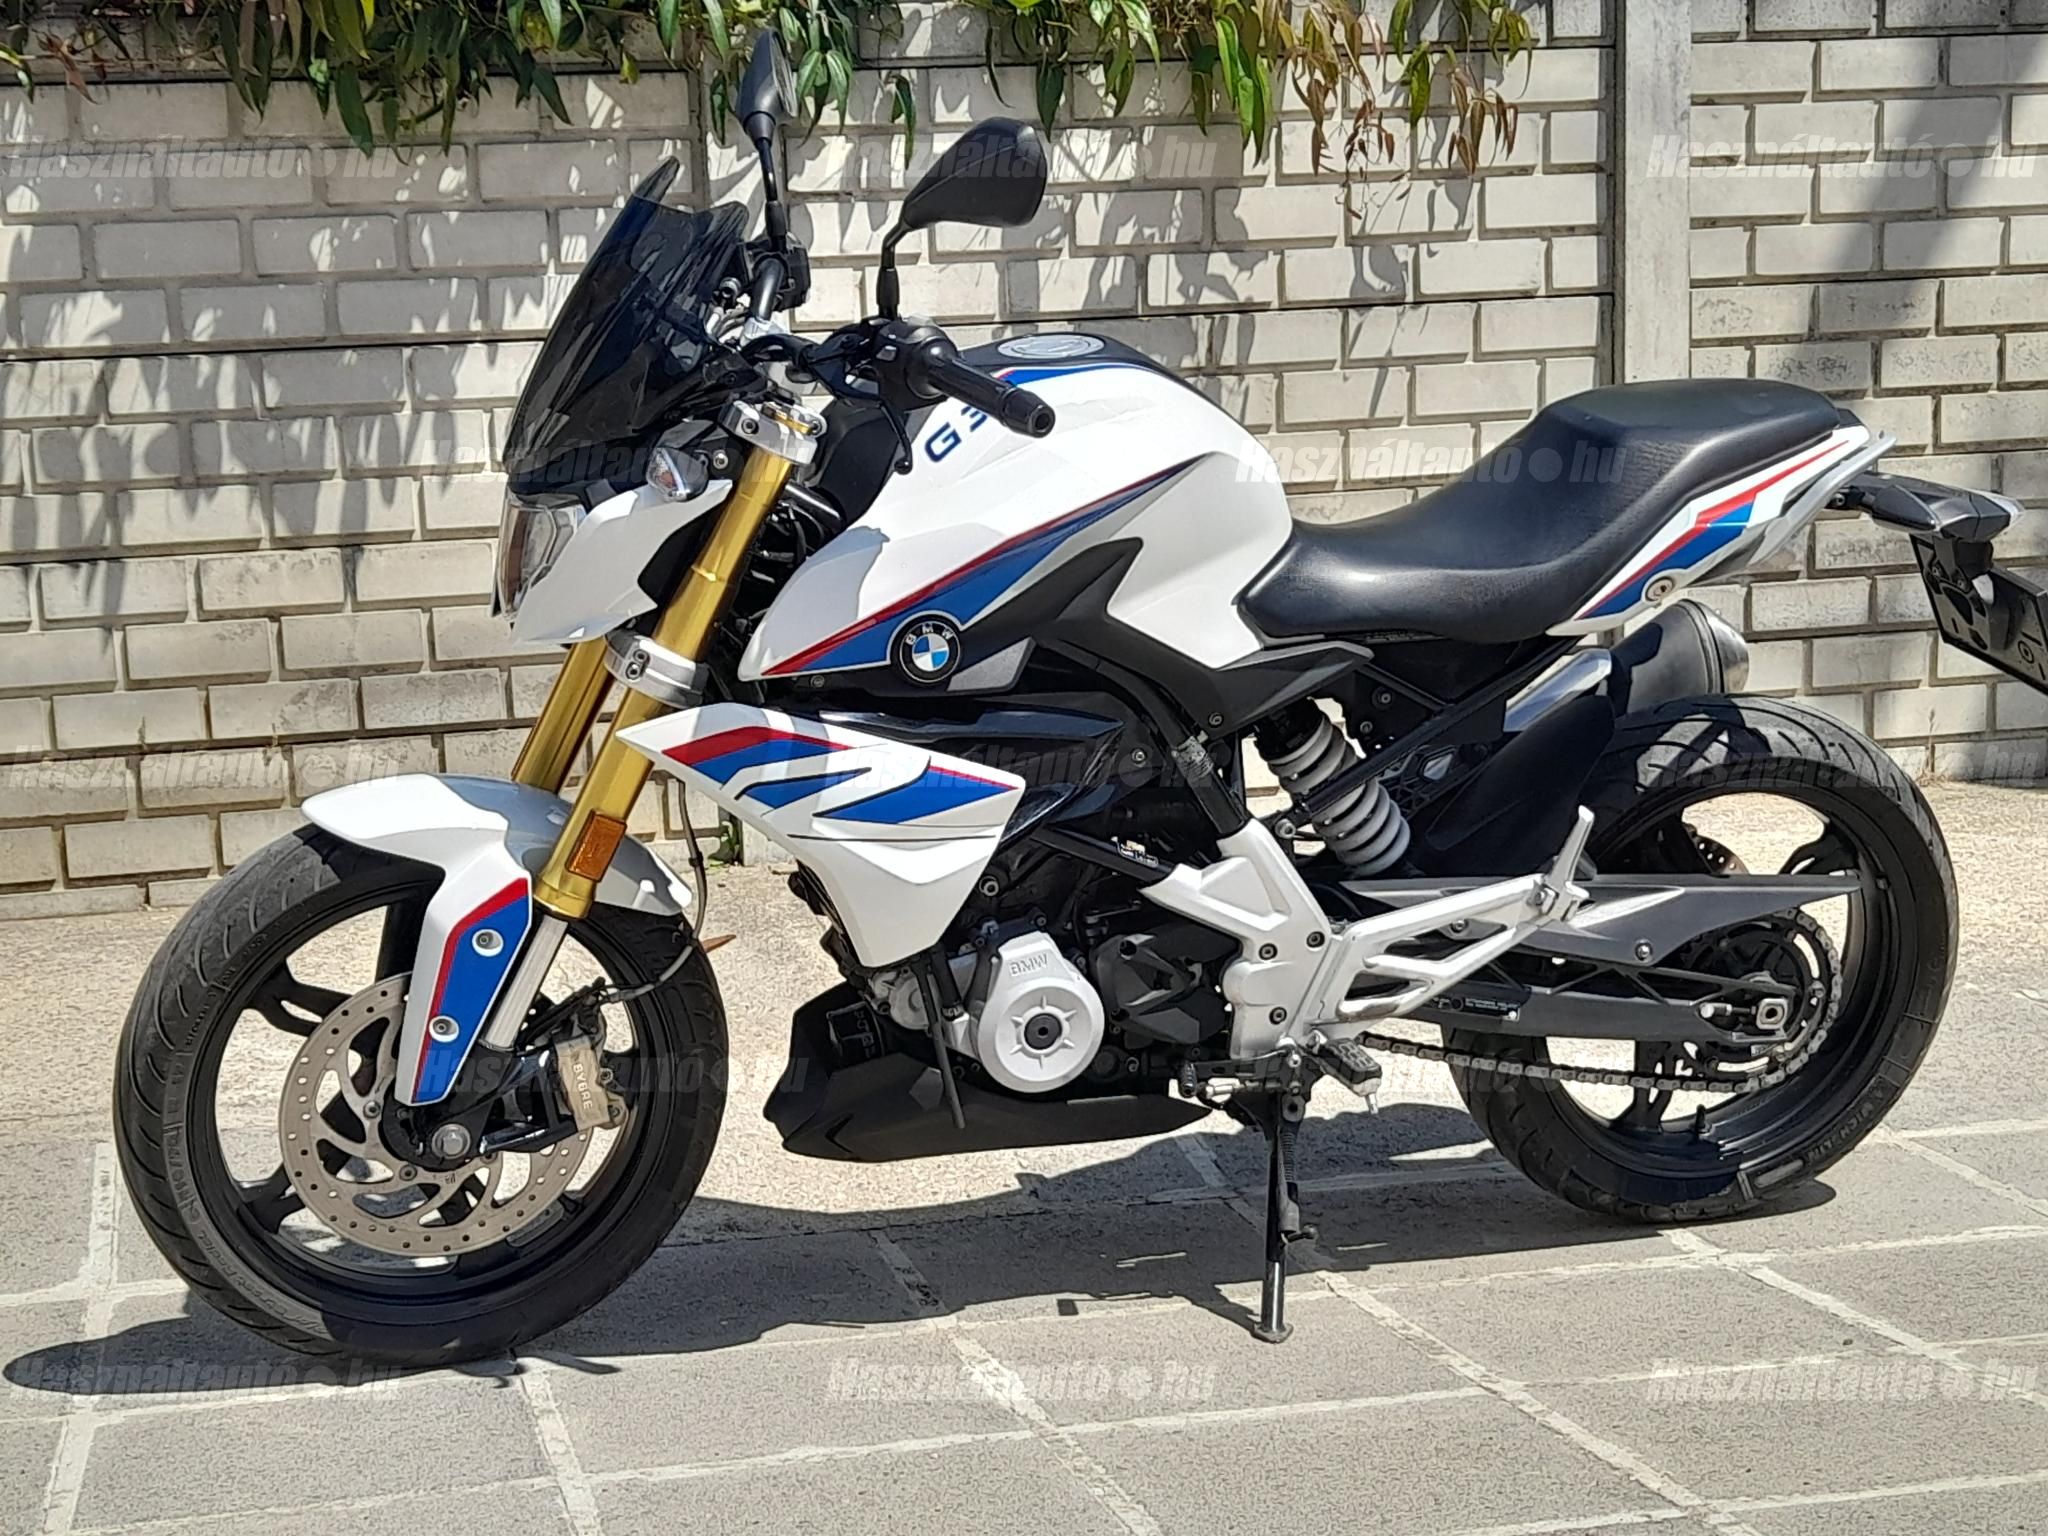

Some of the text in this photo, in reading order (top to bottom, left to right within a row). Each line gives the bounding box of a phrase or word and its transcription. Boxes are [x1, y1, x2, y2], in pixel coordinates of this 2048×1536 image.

[924, 420, 962, 463] G
[905, 622, 954, 646] BMW
[1009, 951, 1048, 976] BMW
[572, 1062, 594, 1110] BYBRE
